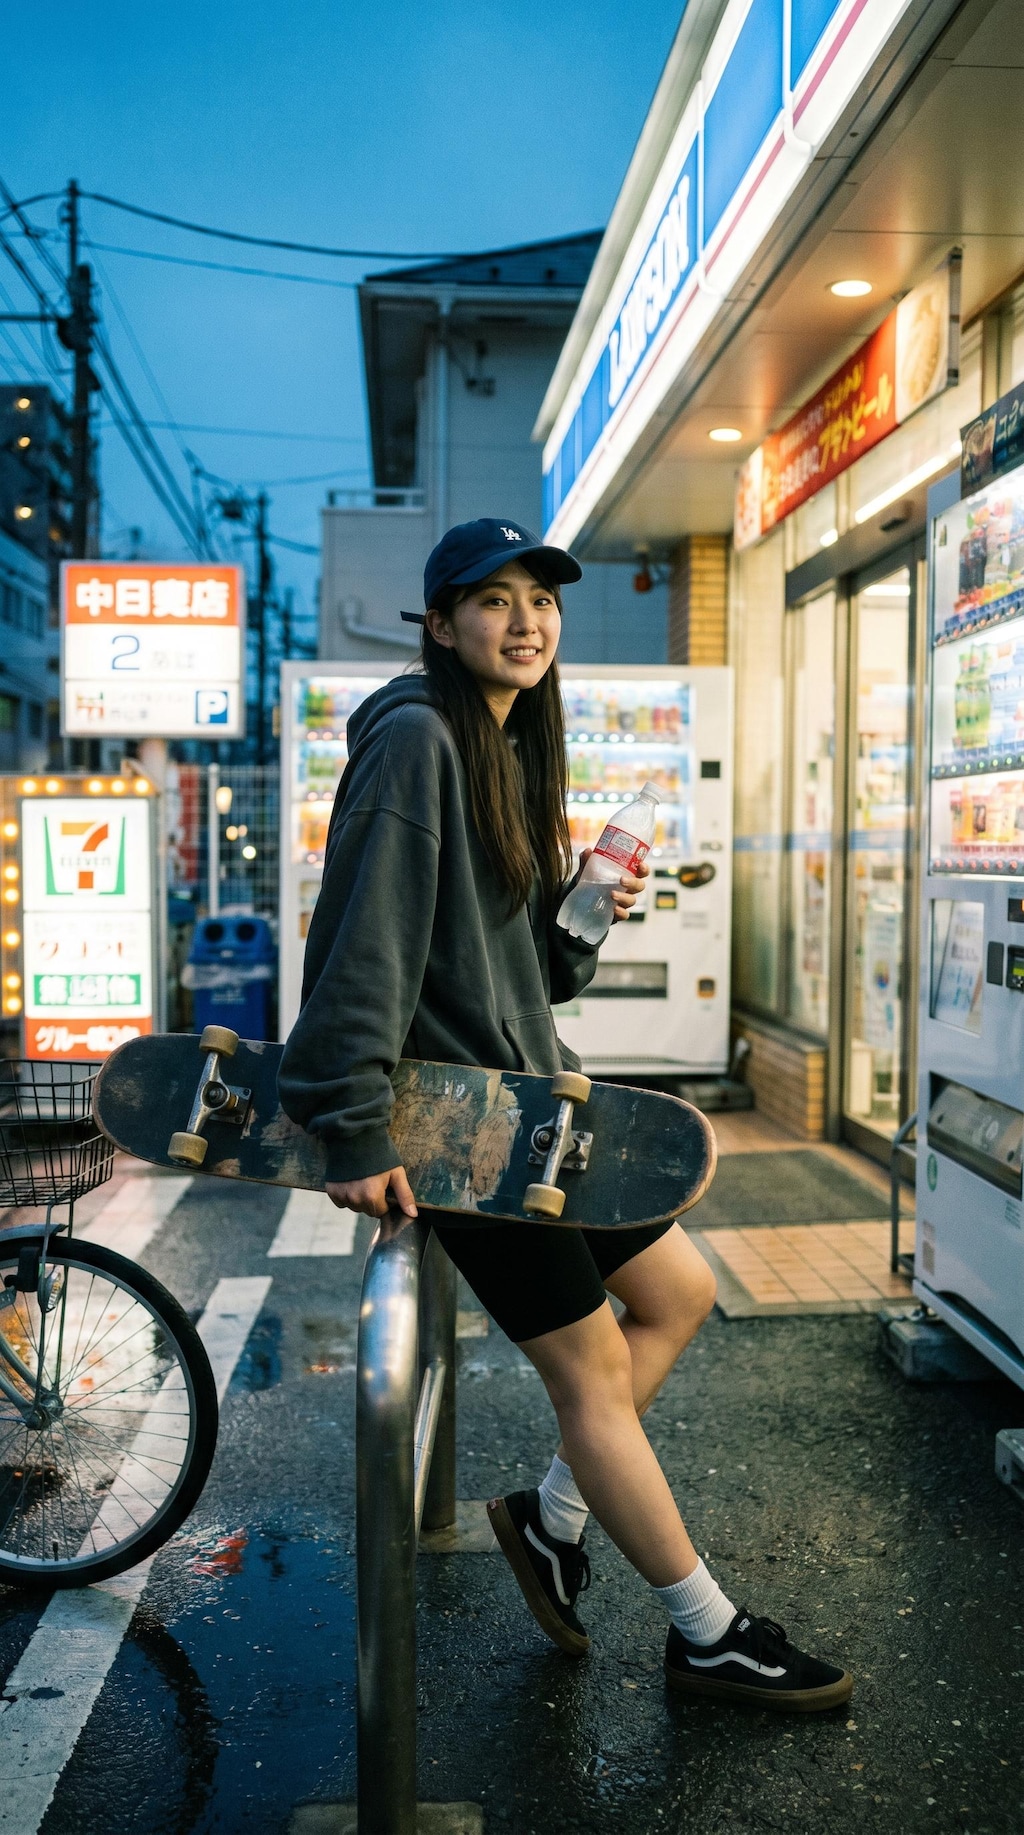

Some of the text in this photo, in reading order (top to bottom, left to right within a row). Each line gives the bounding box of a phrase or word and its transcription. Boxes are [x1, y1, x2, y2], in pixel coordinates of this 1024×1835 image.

[609, 174, 690, 408] LAWSON
[500, 527, 522, 541] LA
[110, 634, 141, 671] 2
[197, 690, 227, 724] P
[59, 820, 110, 890] 7
